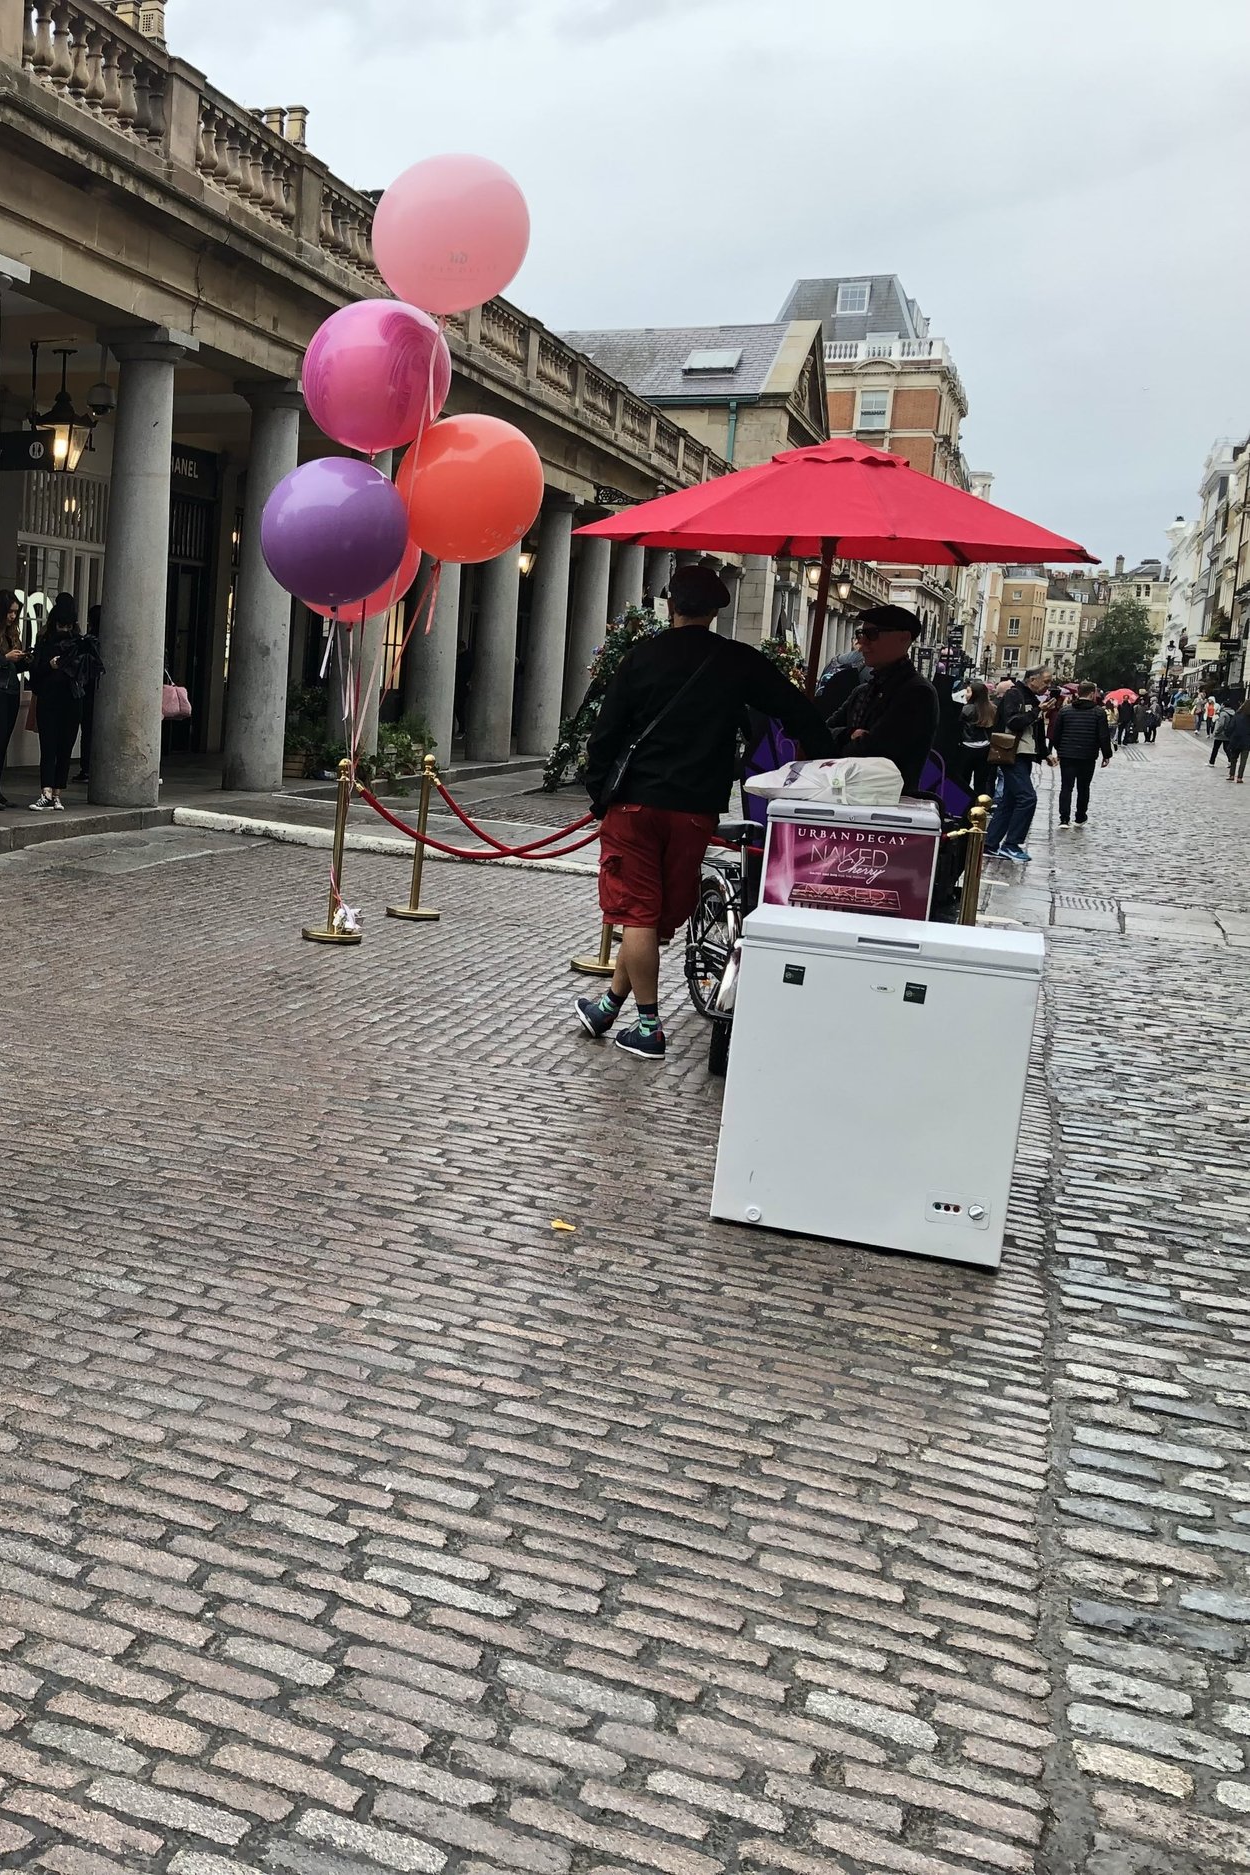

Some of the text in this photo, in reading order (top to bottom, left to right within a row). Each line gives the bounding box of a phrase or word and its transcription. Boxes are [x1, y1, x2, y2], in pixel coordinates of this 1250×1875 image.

[798, 828, 907, 845] URBAN DECAY
[810, 844, 888, 869] NAKED
[837, 856, 886, 885] Cherry
